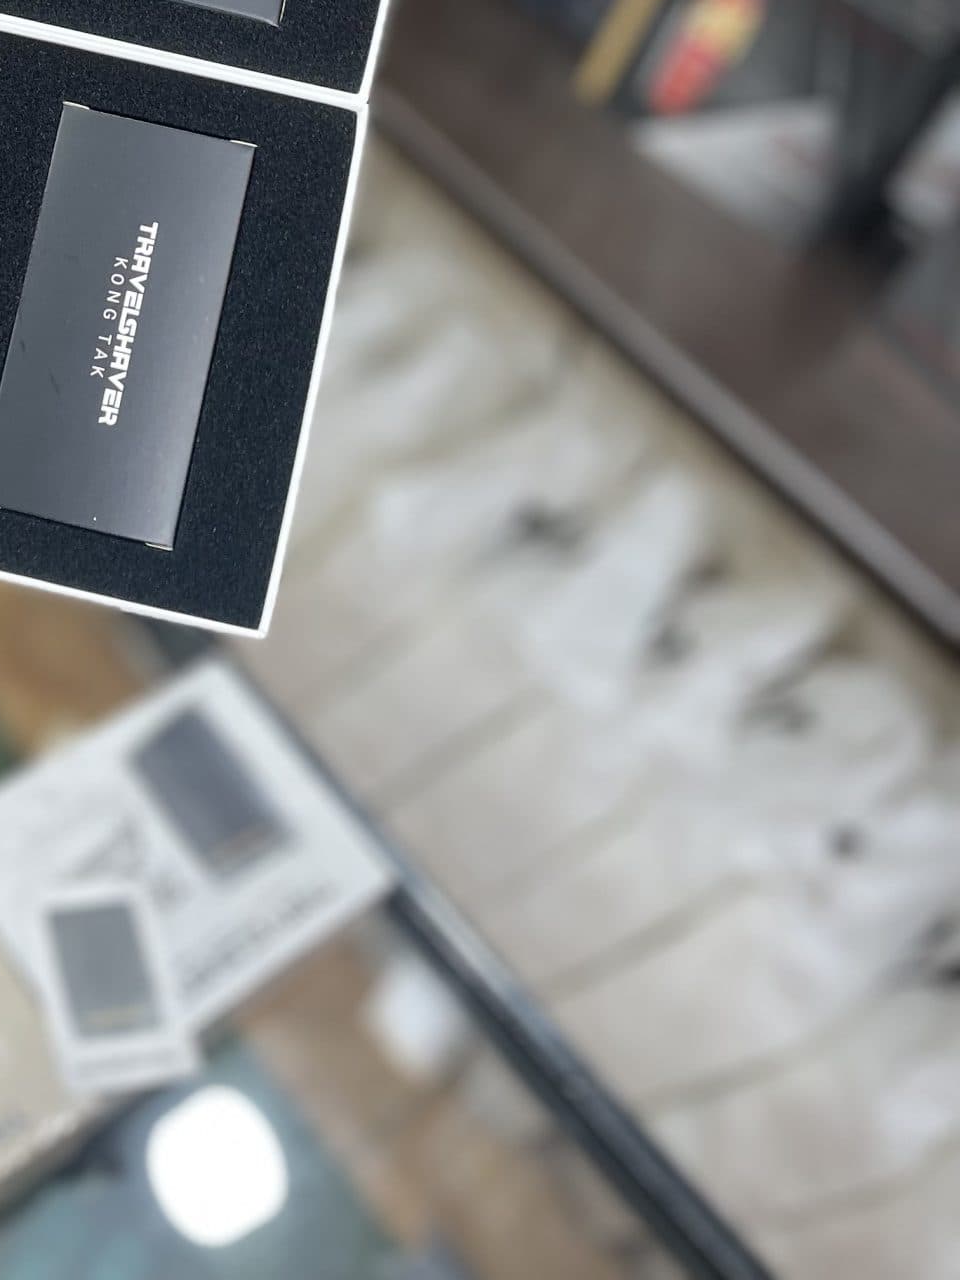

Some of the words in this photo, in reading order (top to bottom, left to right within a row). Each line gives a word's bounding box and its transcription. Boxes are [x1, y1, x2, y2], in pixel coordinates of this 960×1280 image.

[103, 256, 129, 321] KONG
[90, 334, 112, 379] TAK
[98, 222, 159, 426] TRAVELSHAVER
